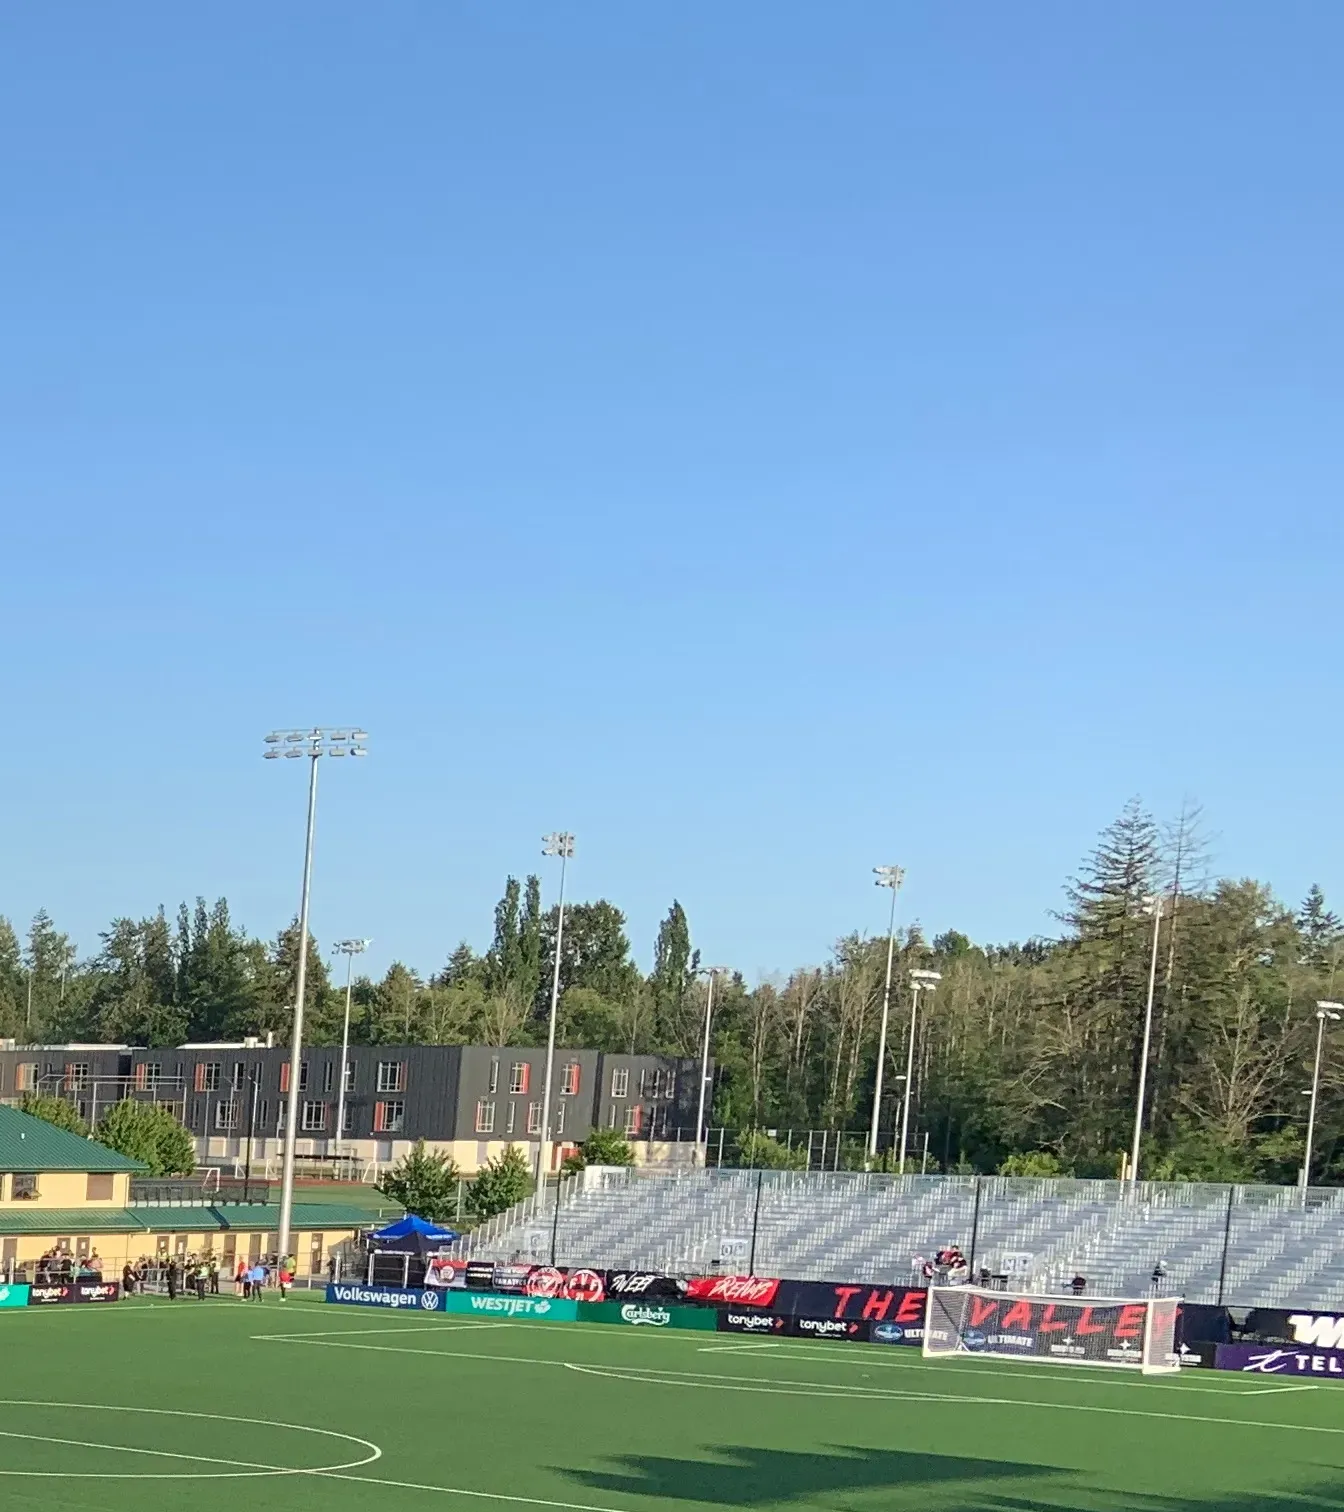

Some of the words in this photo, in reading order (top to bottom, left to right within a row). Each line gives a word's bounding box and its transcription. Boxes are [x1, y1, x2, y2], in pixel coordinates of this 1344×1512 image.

[334, 1286, 416, 1308] Volkswagen
[471, 1297, 534, 1315] WESTJET
[834, 1286, 926, 1323] THE
[621, 1304, 671, 1324] Carlsberg
[727, 1313, 774, 1328] tonybet
[800, 1319, 847, 1333] tonybet
